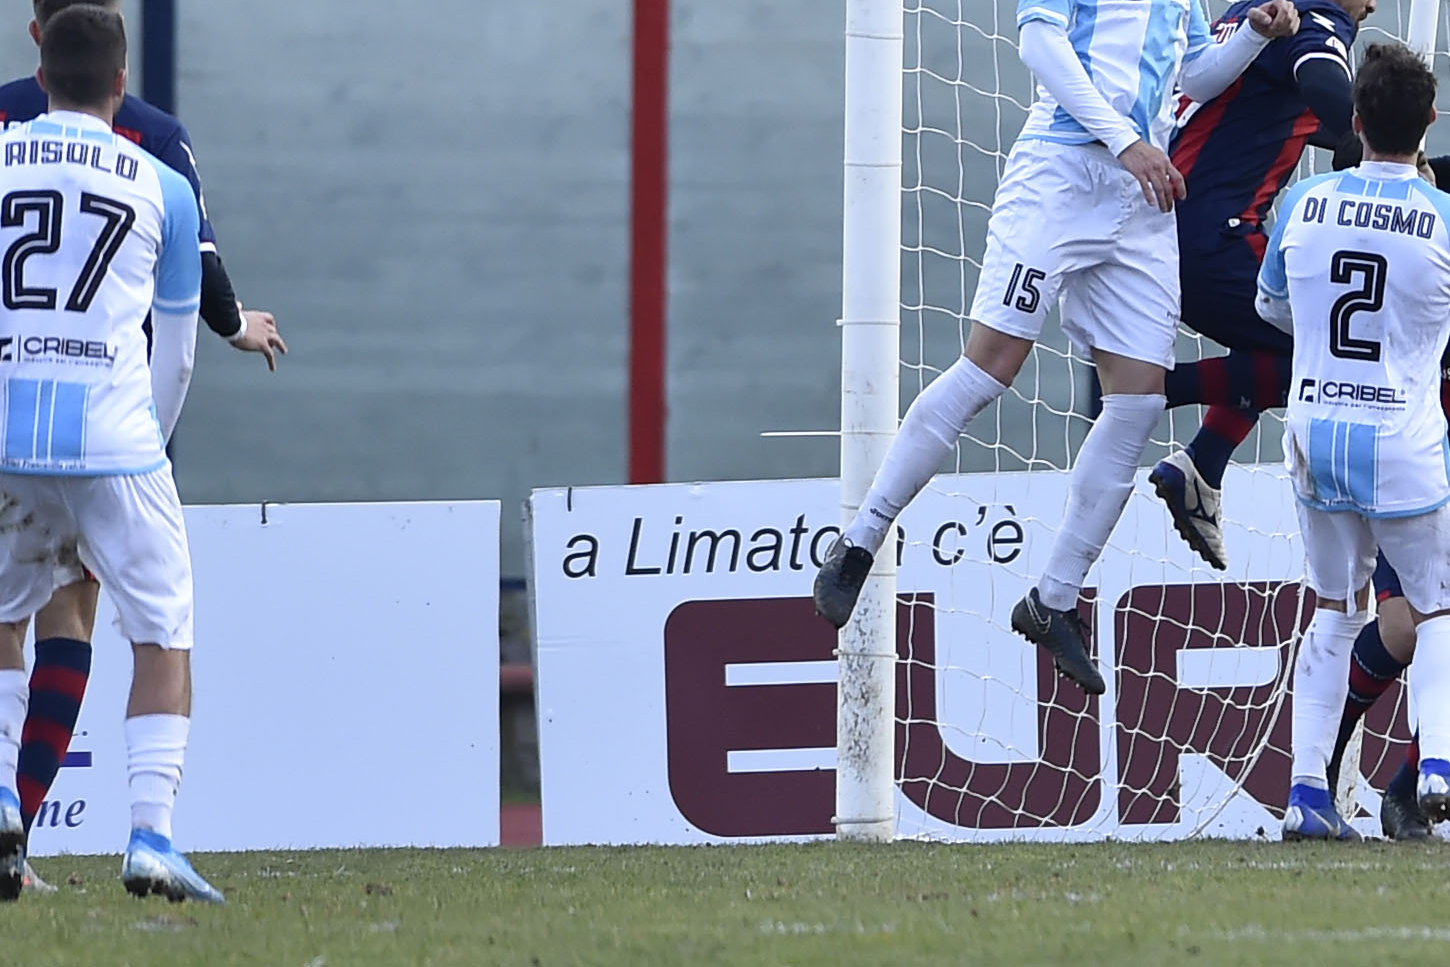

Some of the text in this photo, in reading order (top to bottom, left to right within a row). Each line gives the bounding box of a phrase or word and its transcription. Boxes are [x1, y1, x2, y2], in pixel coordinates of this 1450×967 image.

[1303, 197, 1436, 239] DI COSMO
[1, 190, 135, 312] 27
[1003, 263, 1046, 314] 15
[1330, 250, 1388, 362] 2
[24, 337, 118, 363] CRIBEL
[1322, 381, 1406, 404] CRIBEL
[562, 533, 599, 578] a
[625, 513, 905, 575] Limato
